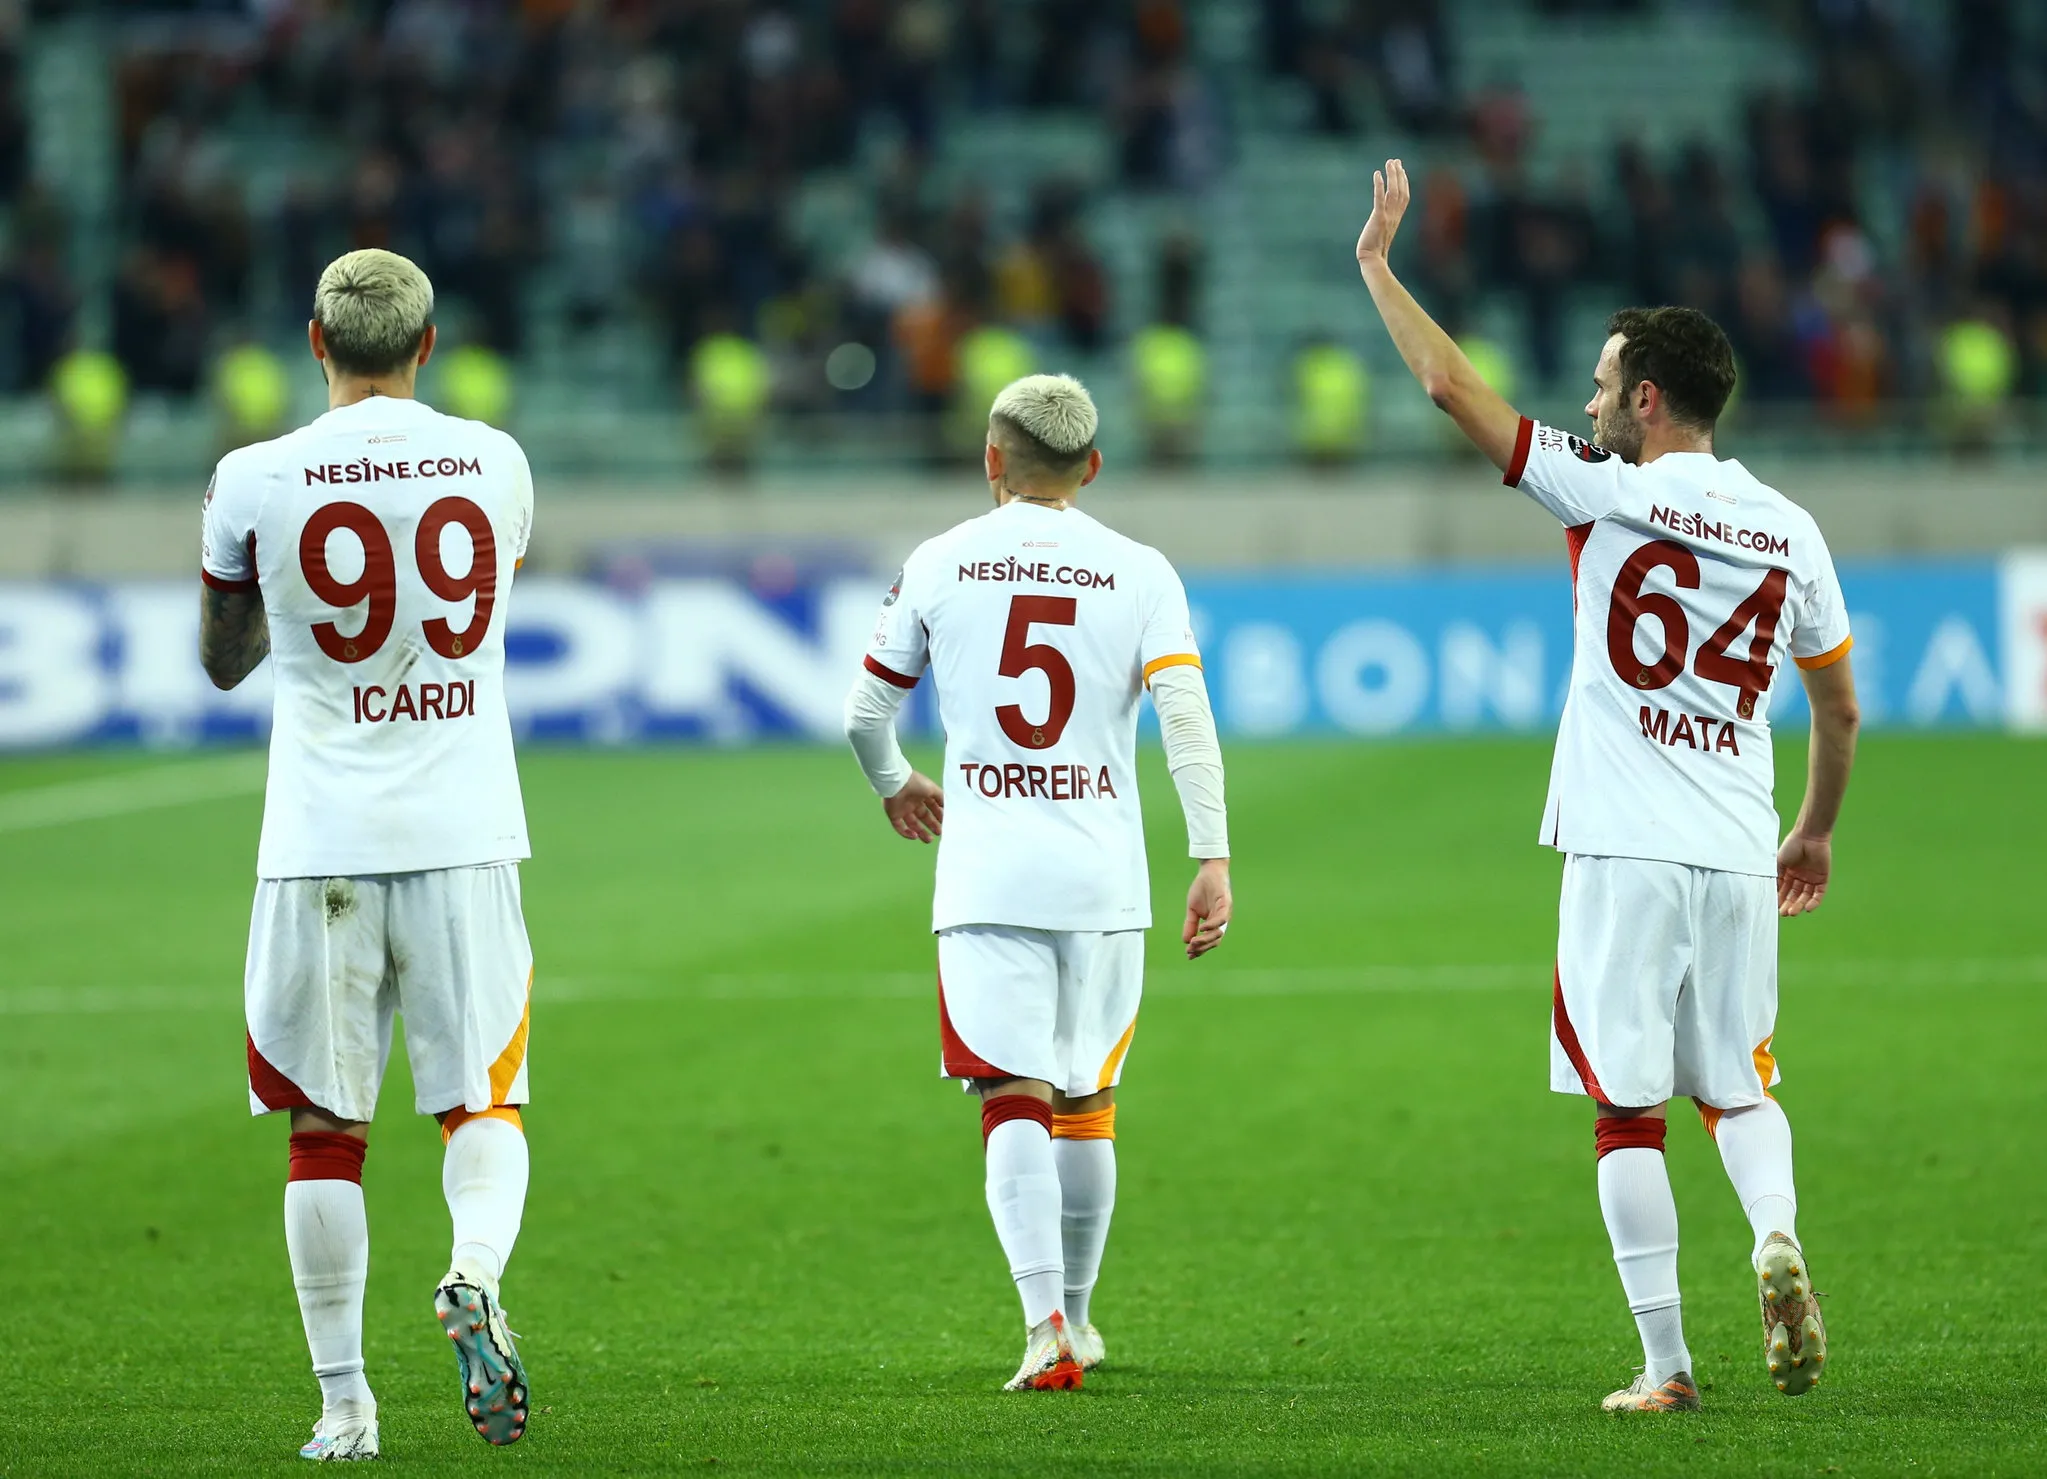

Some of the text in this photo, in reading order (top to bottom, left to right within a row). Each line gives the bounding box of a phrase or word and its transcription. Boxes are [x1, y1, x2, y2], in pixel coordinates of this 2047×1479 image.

[299, 496, 497, 664] 99
[1607, 539, 1789, 721] 64
[353, 680, 475, 724] ICARDI
[994, 594, 1077, 750] 5
[1222, 616, 1574, 738] BON
[1639, 705, 1741, 756] MATA
[960, 763, 1118, 801] TORREIRA
